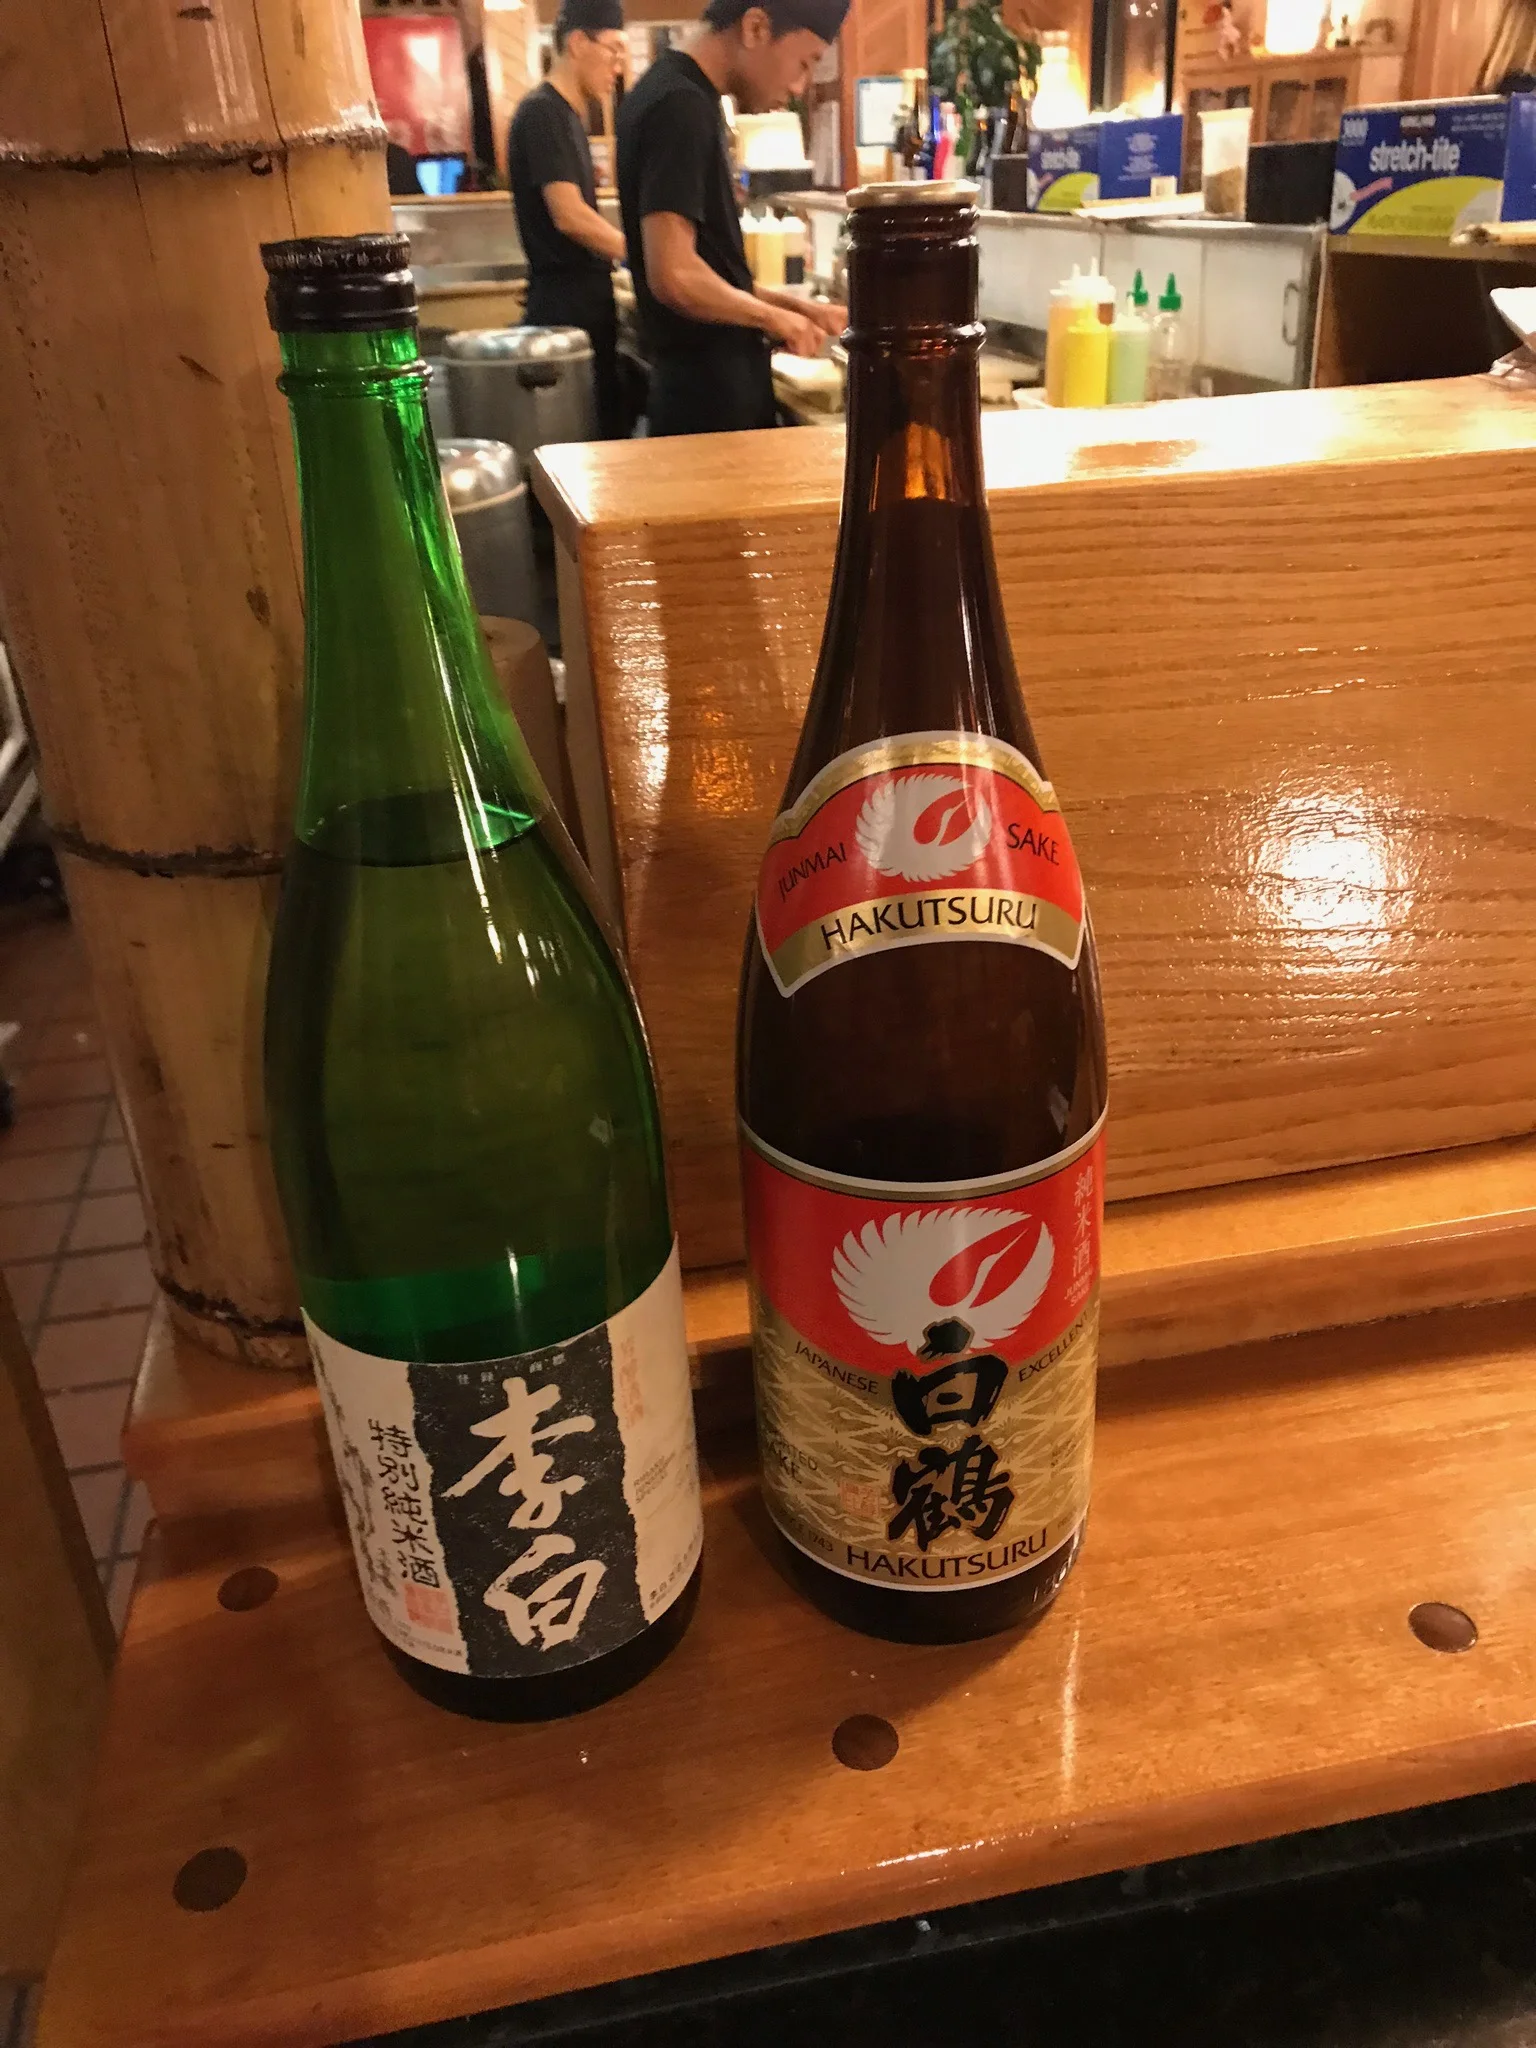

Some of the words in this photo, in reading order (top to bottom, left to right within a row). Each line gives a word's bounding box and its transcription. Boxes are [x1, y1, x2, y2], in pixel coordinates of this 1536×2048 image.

[1369, 136, 1461, 173] stretch-tite
[777, 843, 847, 901] JUNMAI
[1007, 823, 1060, 866] SAKE
[821, 896, 1039, 951] HAKUTSURU
[1072, 1165, 1094, 1277] 純米酒
[794, 1340, 879, 1395] JAPANESE
[886, 1315, 1015, 1553] 白鶴
[368, 1418, 440, 1589] 特別純米酒
[440, 1376, 608, 1653] 李白
[846, 1528, 1048, 1580] HAKUTSURU
